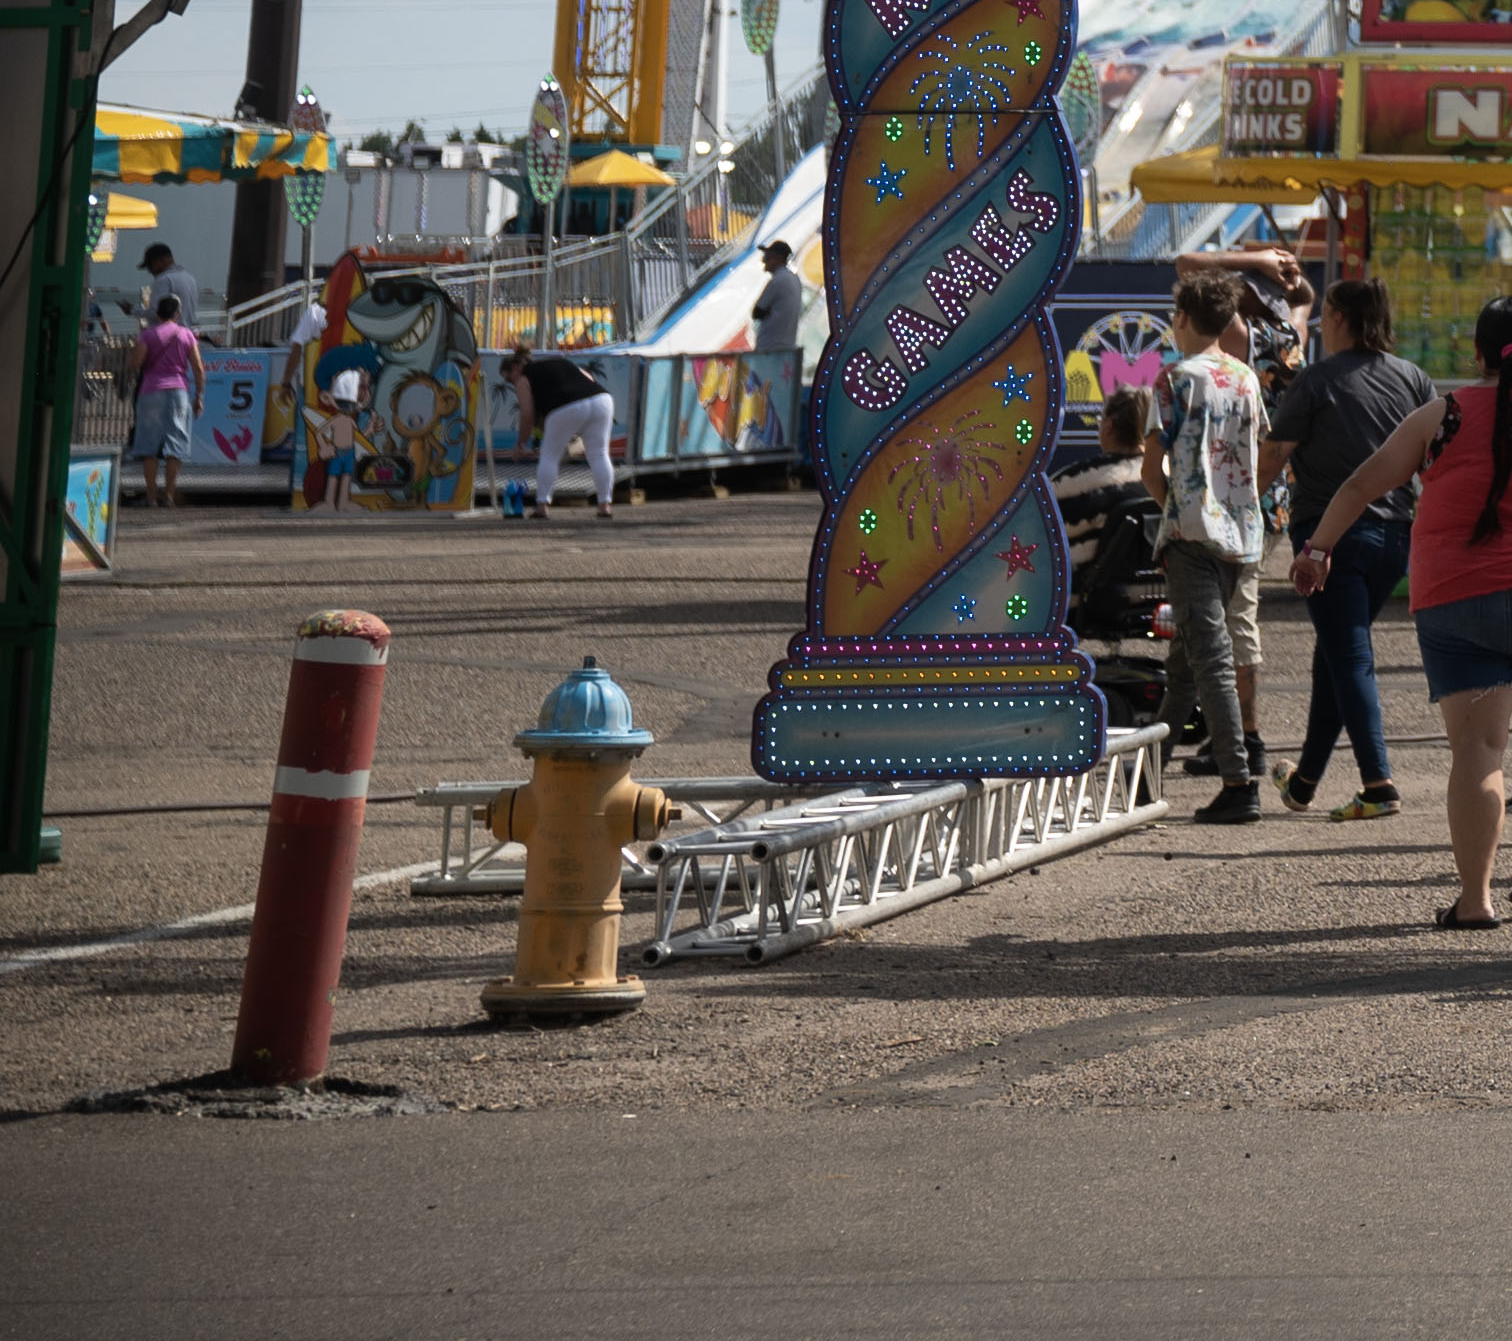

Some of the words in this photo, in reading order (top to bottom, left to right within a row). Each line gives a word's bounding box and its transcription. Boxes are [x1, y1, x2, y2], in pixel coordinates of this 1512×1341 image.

[1245, 78, 1312, 107] COLD
[842, 166, 1061, 413] GAMES
[229, 379, 255, 413] 5
[1064, 349, 1185, 403] AM
